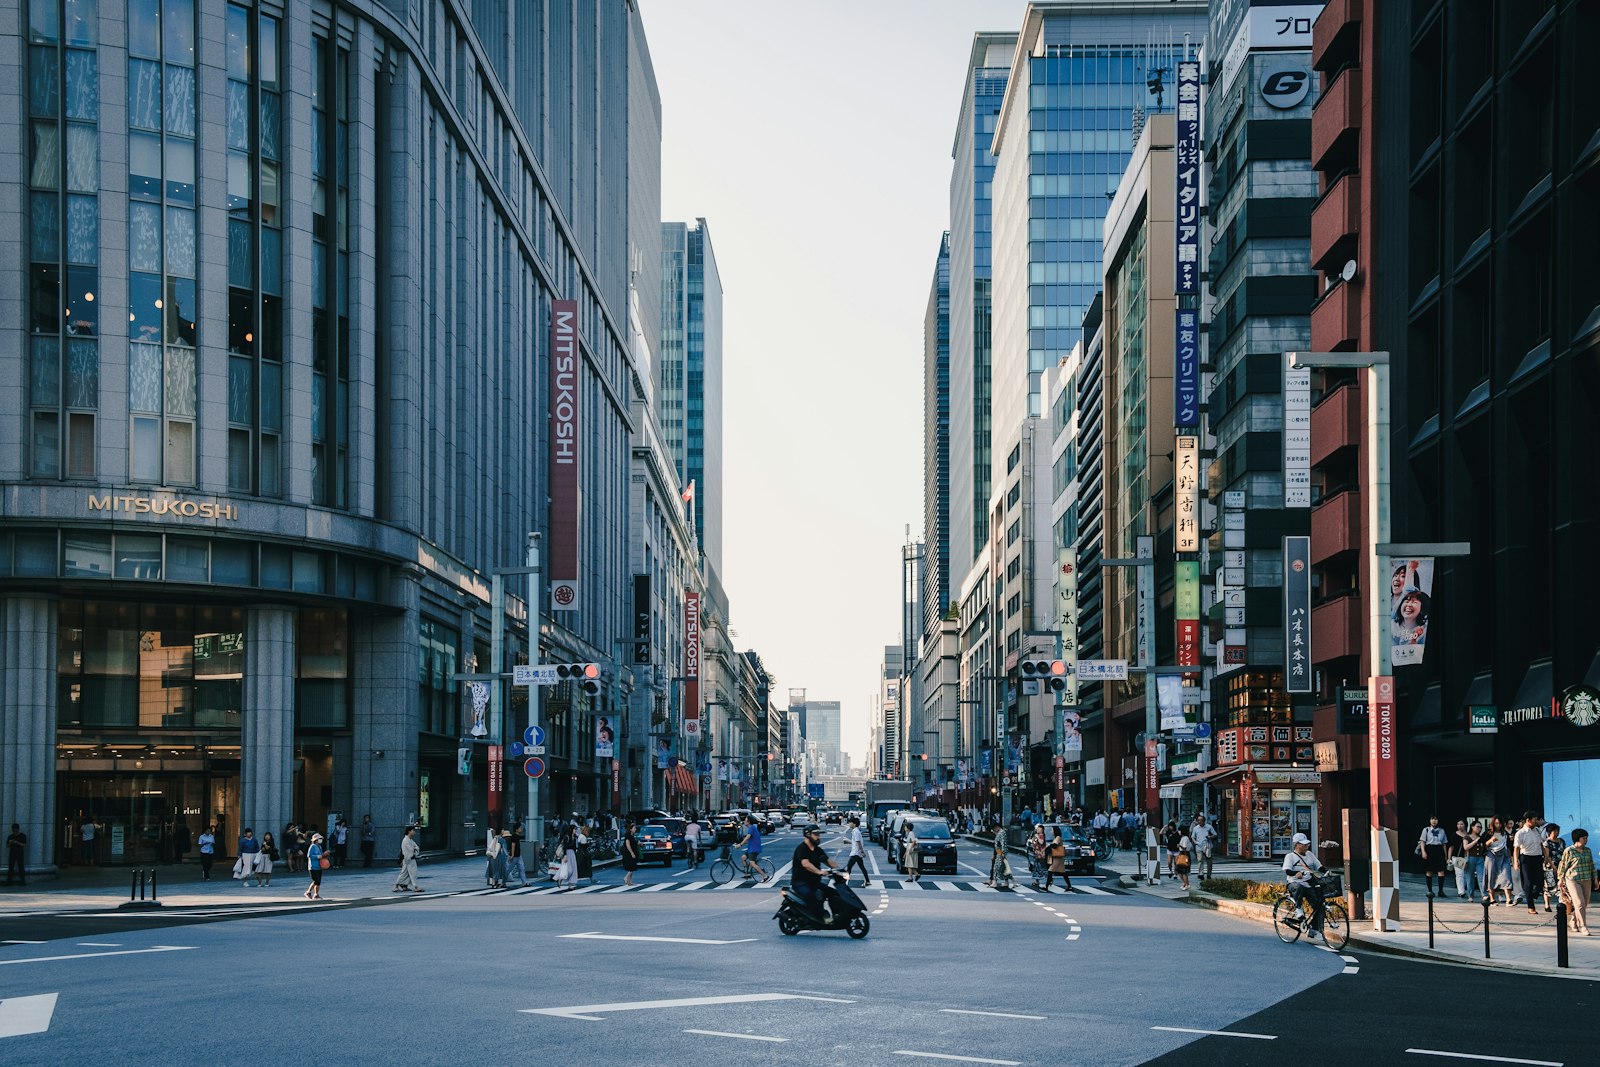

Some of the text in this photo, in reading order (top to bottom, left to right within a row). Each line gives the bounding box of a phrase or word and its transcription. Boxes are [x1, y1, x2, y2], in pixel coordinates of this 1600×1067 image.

[1275, 16, 1311, 35] プロ
[1179, 63, 1198, 121] 英会話
[1262, 71, 1307, 95] G
[1179, 167, 1197, 262] イタリア語
[1183, 264, 1192, 289] チャオ
[1180, 314, 1194, 422] 恵友クリニック
[556, 311, 574, 464] MITSUKOSHI
[1179, 455, 1195, 534] 天野歯科
[88, 494, 239, 521] MITSUKOSHI
[1181, 539, 1194, 547] 3F
[687, 598, 697, 678] MITSUKOSH
[516, 670, 555, 679] 日本橋北詰
[1079, 665, 1124, 673] 日本橋北詰
[1381, 704, 1391, 735] TOKYO
[1503, 706, 1543, 725] TRATTORIA
[1250, 726, 1313, 742] 高価買
[1382, 736, 1391, 759] 2020
[174, 806, 201, 815] rluti
